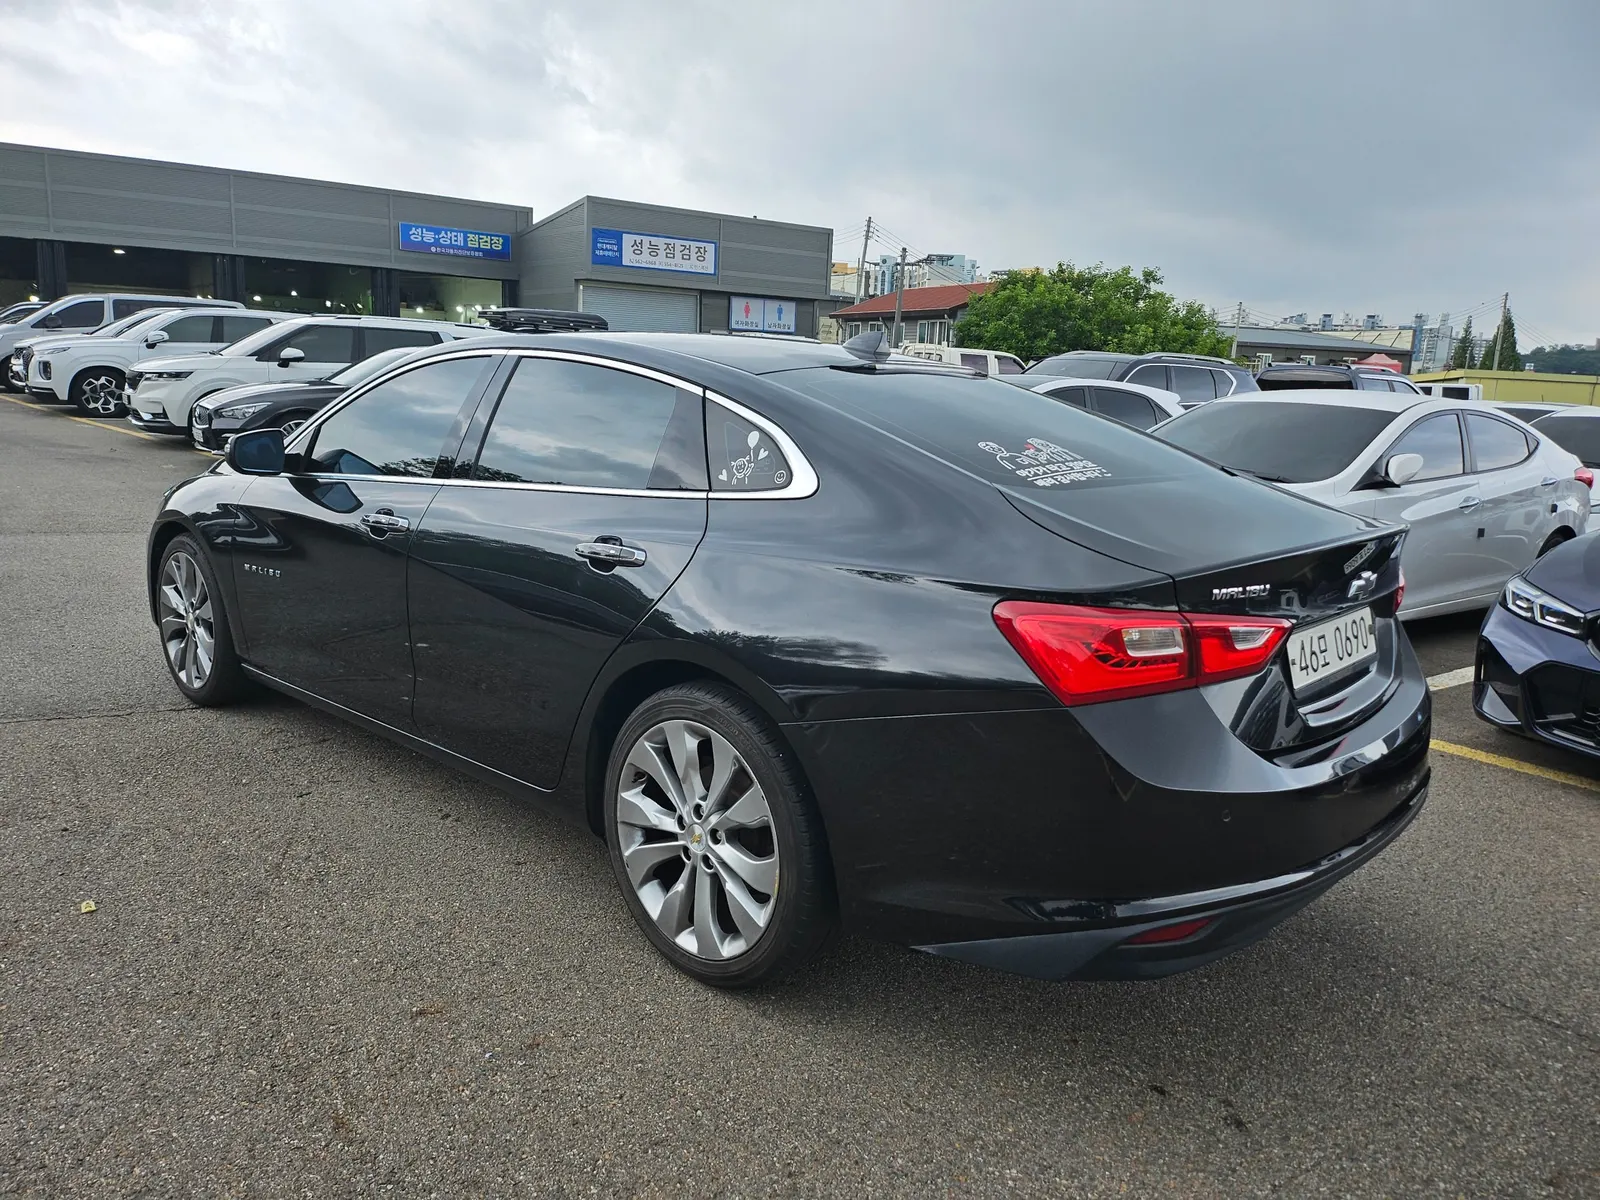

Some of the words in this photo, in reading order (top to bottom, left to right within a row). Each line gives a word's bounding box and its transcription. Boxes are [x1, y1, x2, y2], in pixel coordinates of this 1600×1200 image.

[467, 233, 503, 250] 점검장
[631, 239, 707, 262] 성능점검장
[244, 563, 281, 577] MALIBU
[1212, 584, 1271, 600] MALIBU
[1300, 634, 1330, 676] 46모
[1334, 616, 1369, 661] 0690
